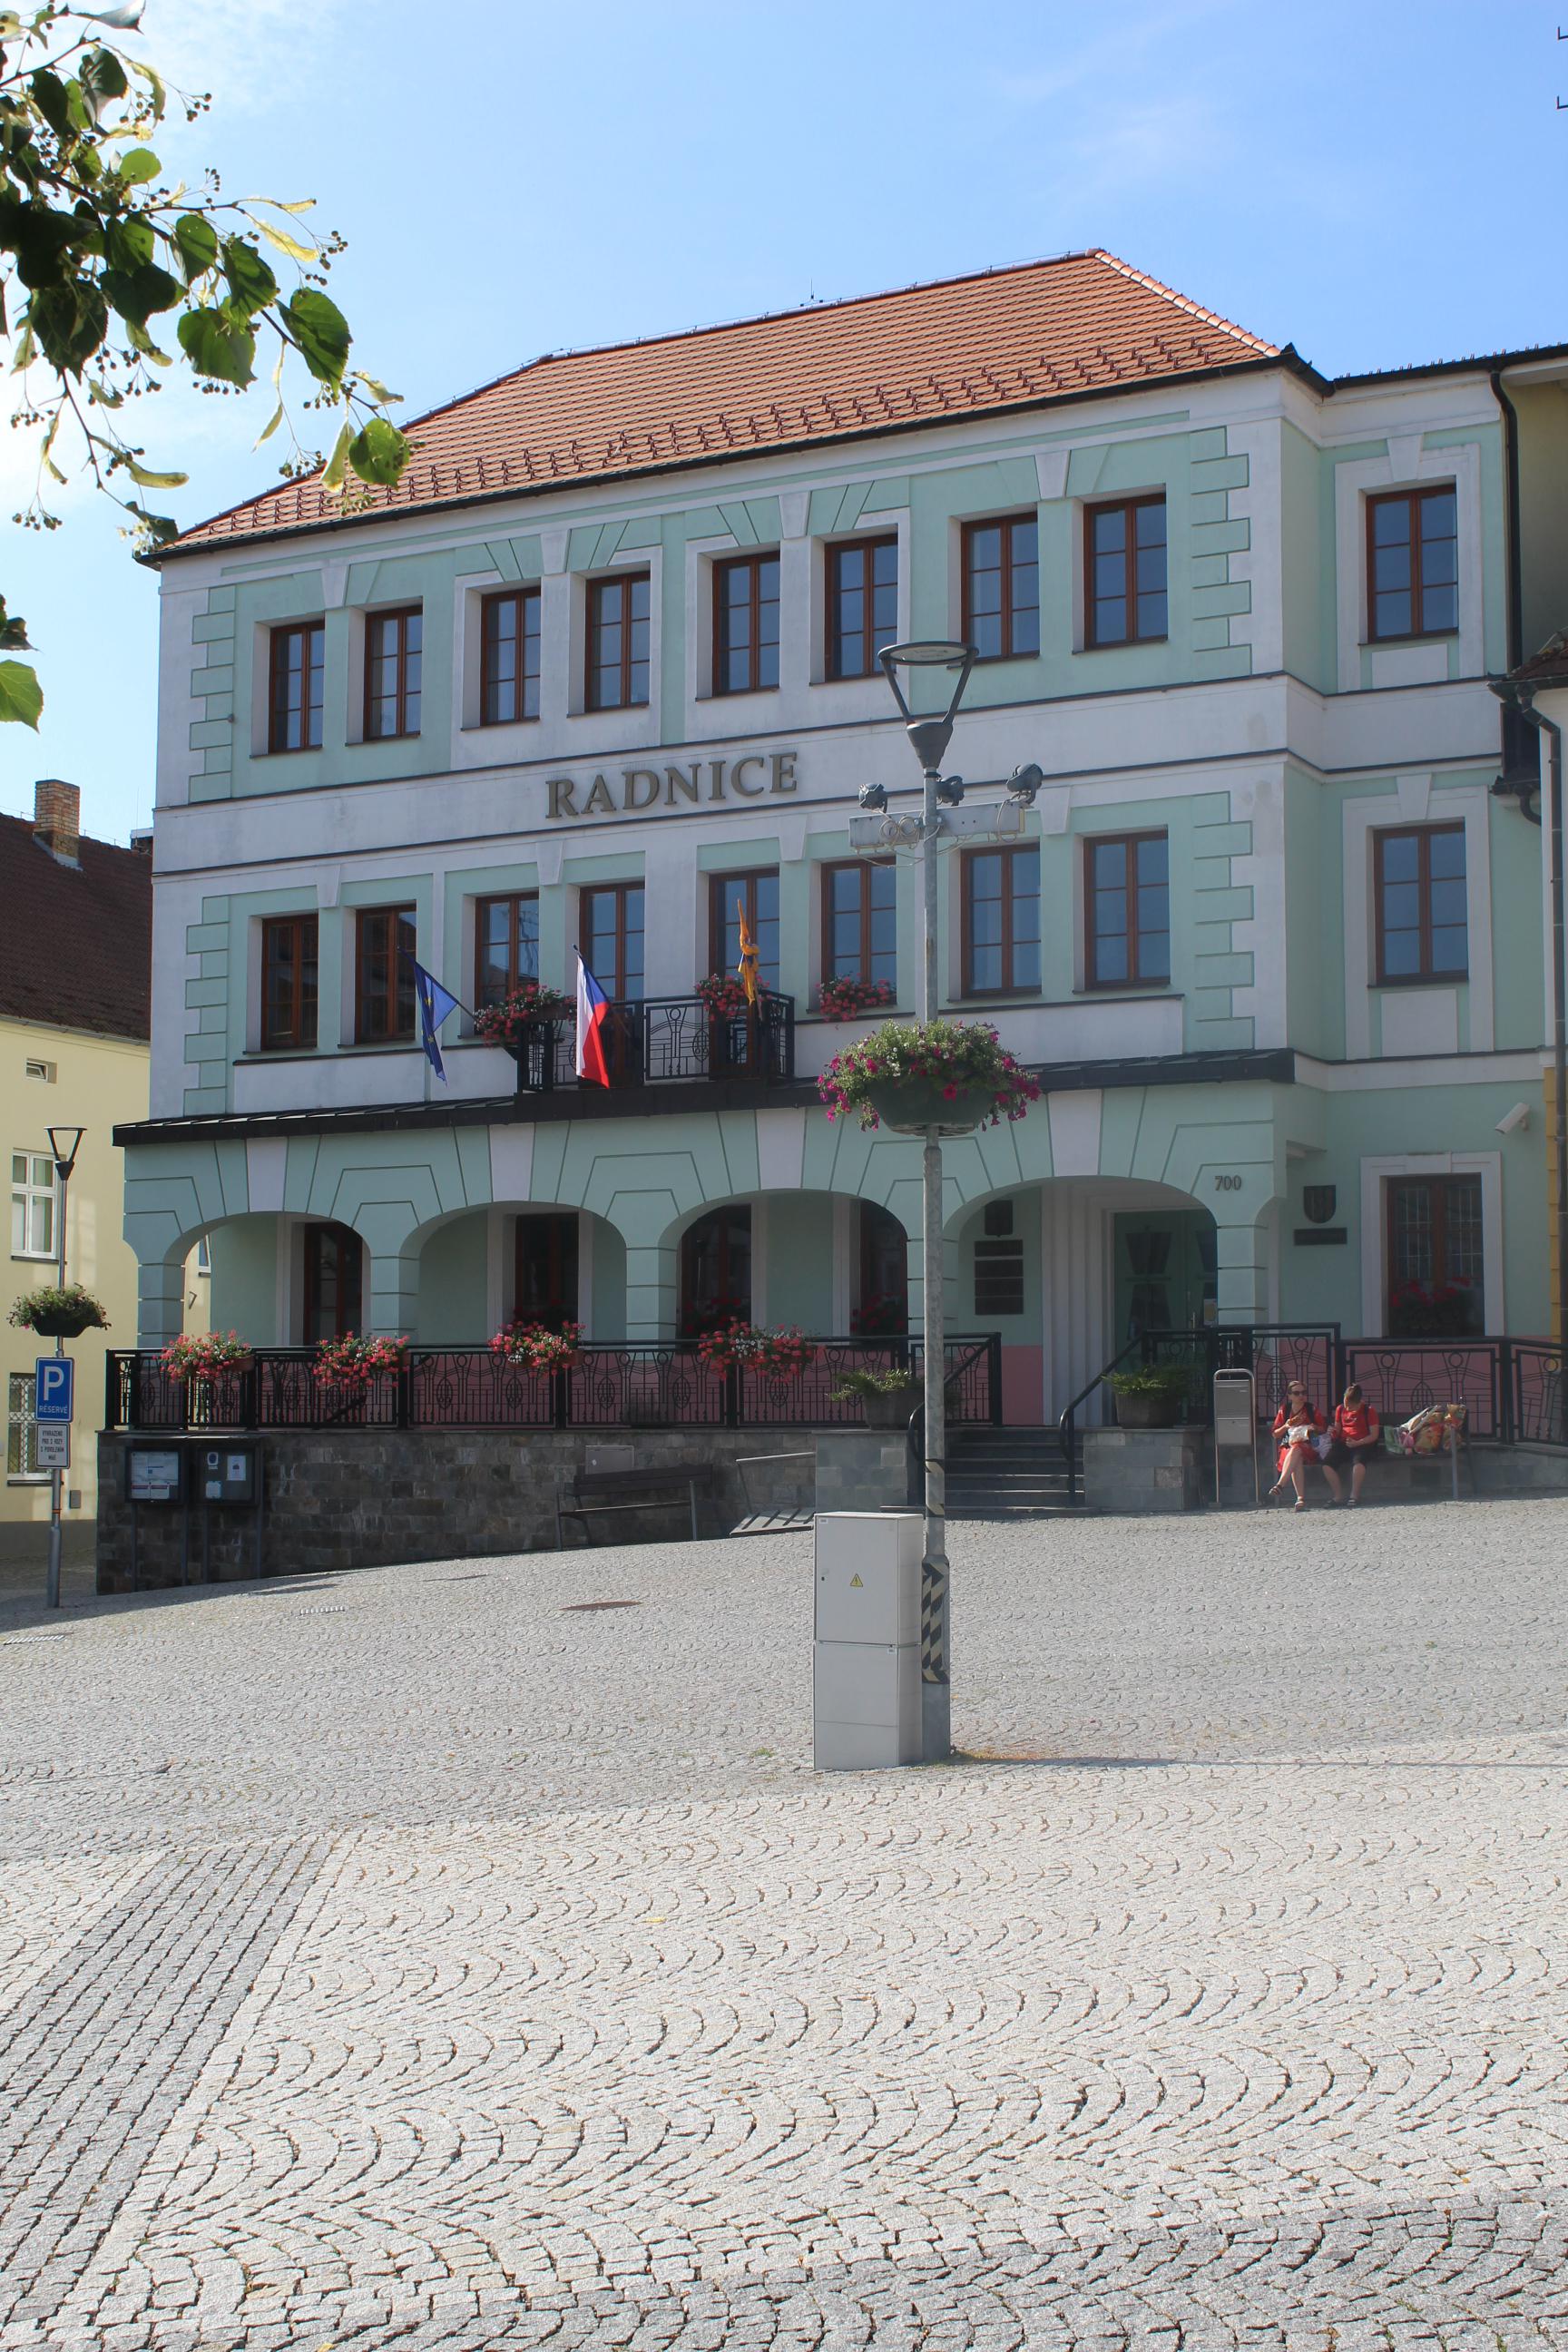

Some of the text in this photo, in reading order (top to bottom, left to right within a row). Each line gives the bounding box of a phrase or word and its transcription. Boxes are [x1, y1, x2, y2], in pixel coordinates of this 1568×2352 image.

[545, 751, 798, 818] RADNICE
[1214, 1174, 1242, 1191] 700
[44, 1366, 64, 1401] P
